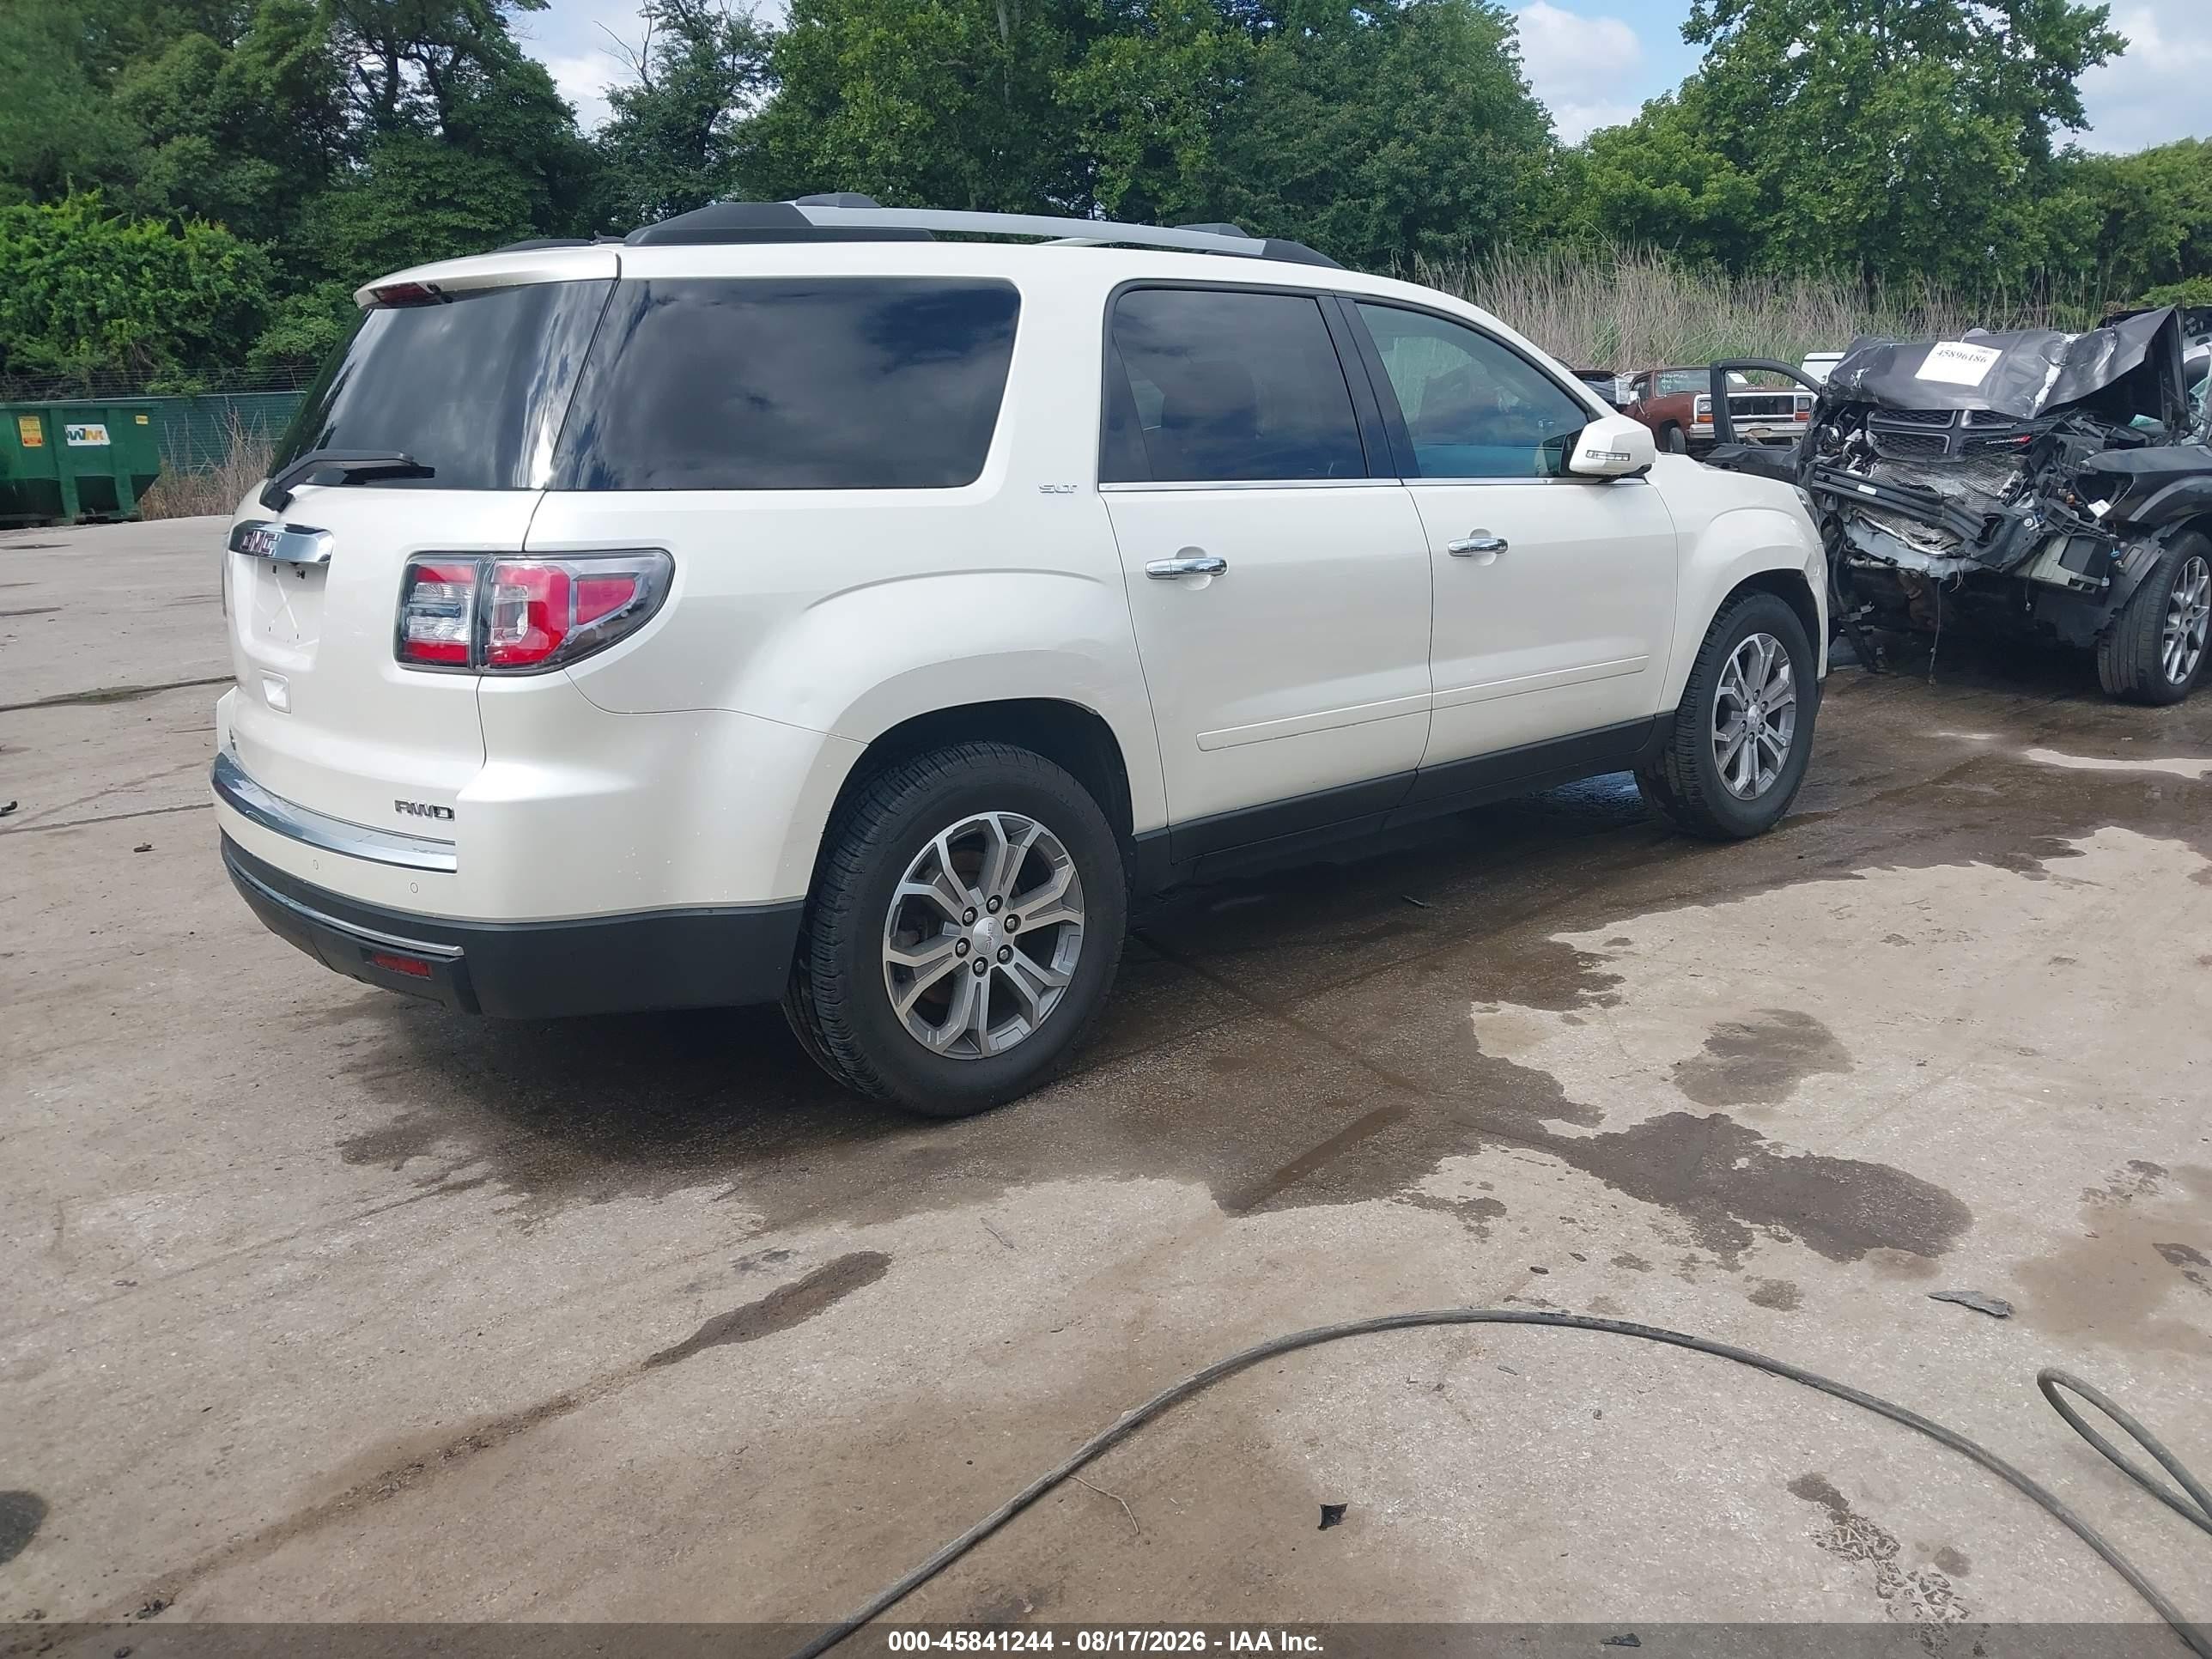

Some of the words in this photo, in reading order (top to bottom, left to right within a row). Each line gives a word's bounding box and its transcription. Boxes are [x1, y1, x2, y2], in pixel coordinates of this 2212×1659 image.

[1936, 349, 1987, 363] 45896186
[1038, 483, 1079, 494] SLT
[240, 531, 281, 557] GMC
[394, 799, 455, 821] AWD
